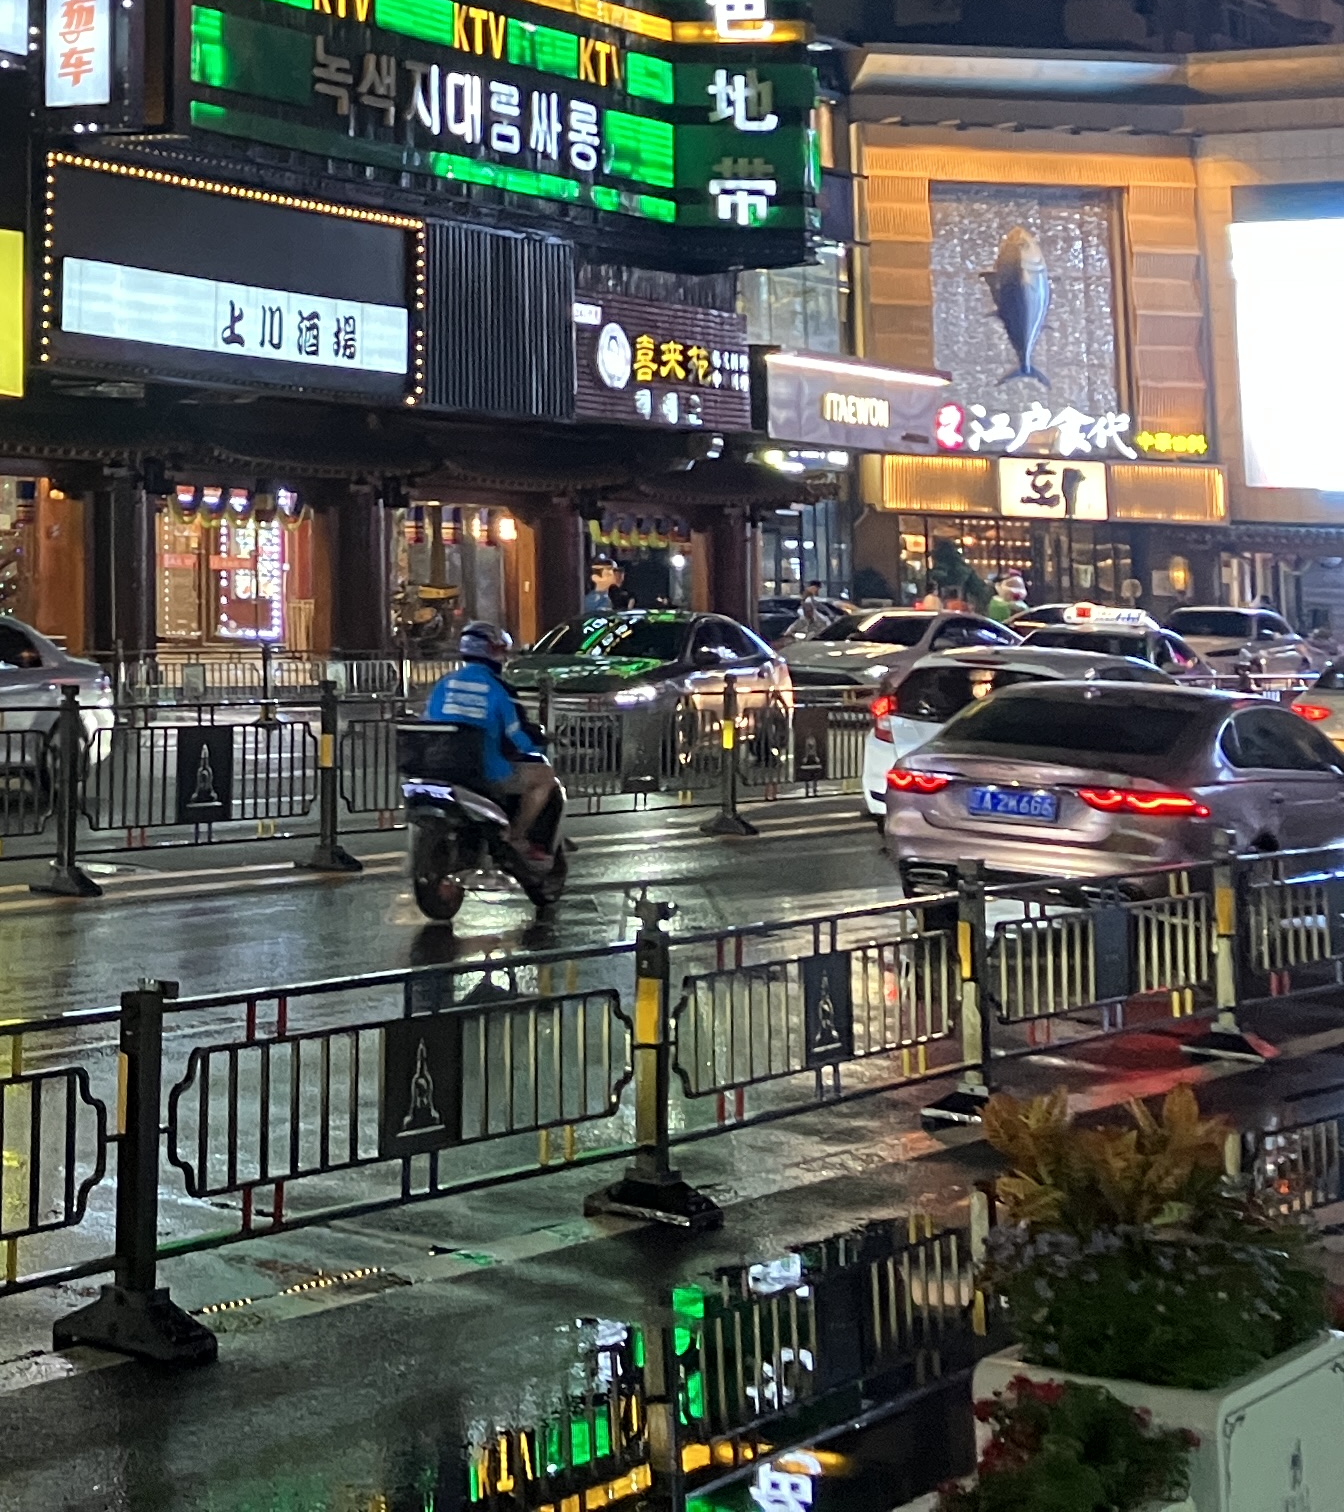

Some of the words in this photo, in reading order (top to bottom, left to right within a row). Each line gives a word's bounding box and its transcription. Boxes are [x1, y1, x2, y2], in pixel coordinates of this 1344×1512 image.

[453, 1, 507, 62] KTV
[822, 391, 890, 428] ITAEWON
[968, 401, 1137, 460] 江户食代
